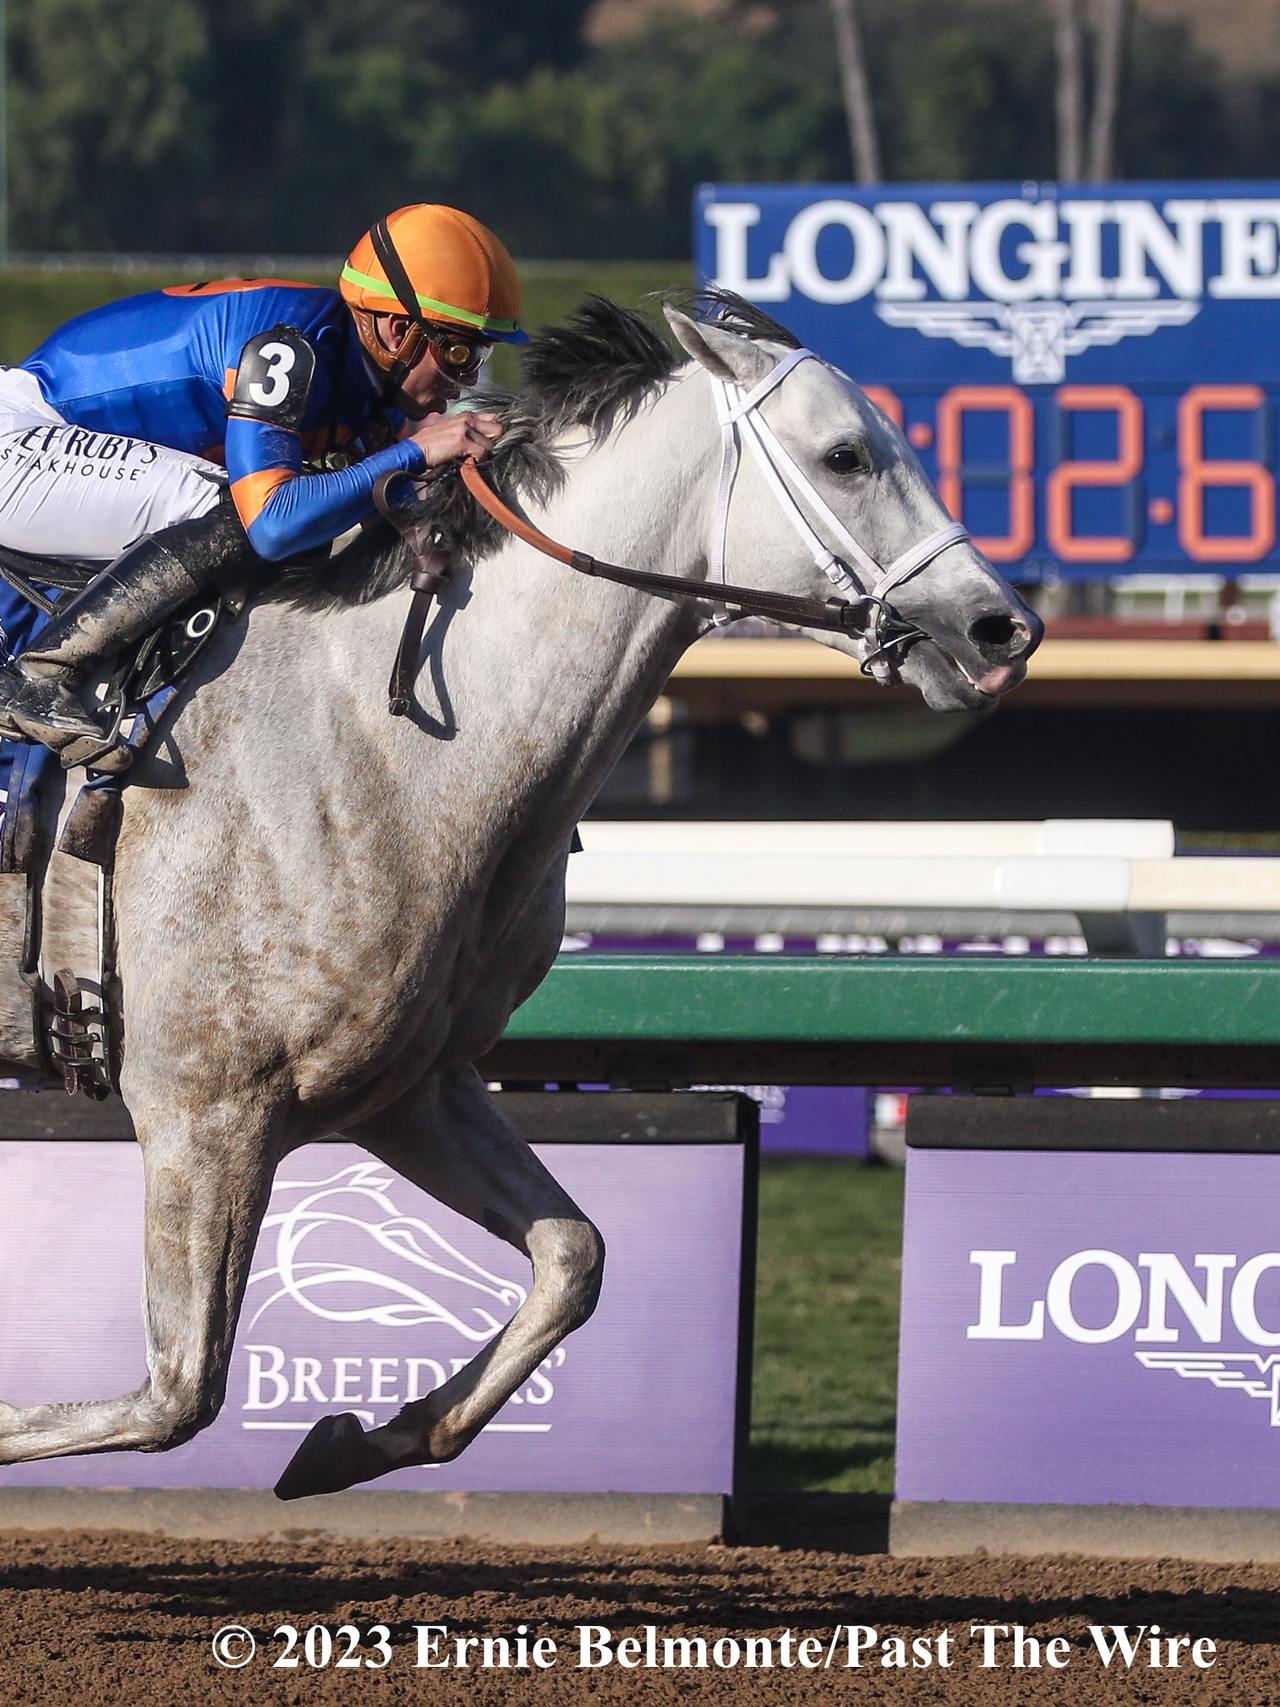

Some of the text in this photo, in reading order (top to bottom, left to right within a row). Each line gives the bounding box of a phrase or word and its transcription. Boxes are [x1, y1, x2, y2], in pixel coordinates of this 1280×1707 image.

[704, 200, 1280, 304] LONGINE
[249, 342, 295, 406] 3
[1, 448, 142, 481] STAKHOUSE
[65, 428, 158, 465] RUBY'S
[242, 1344, 567, 1405] BREEDS'
